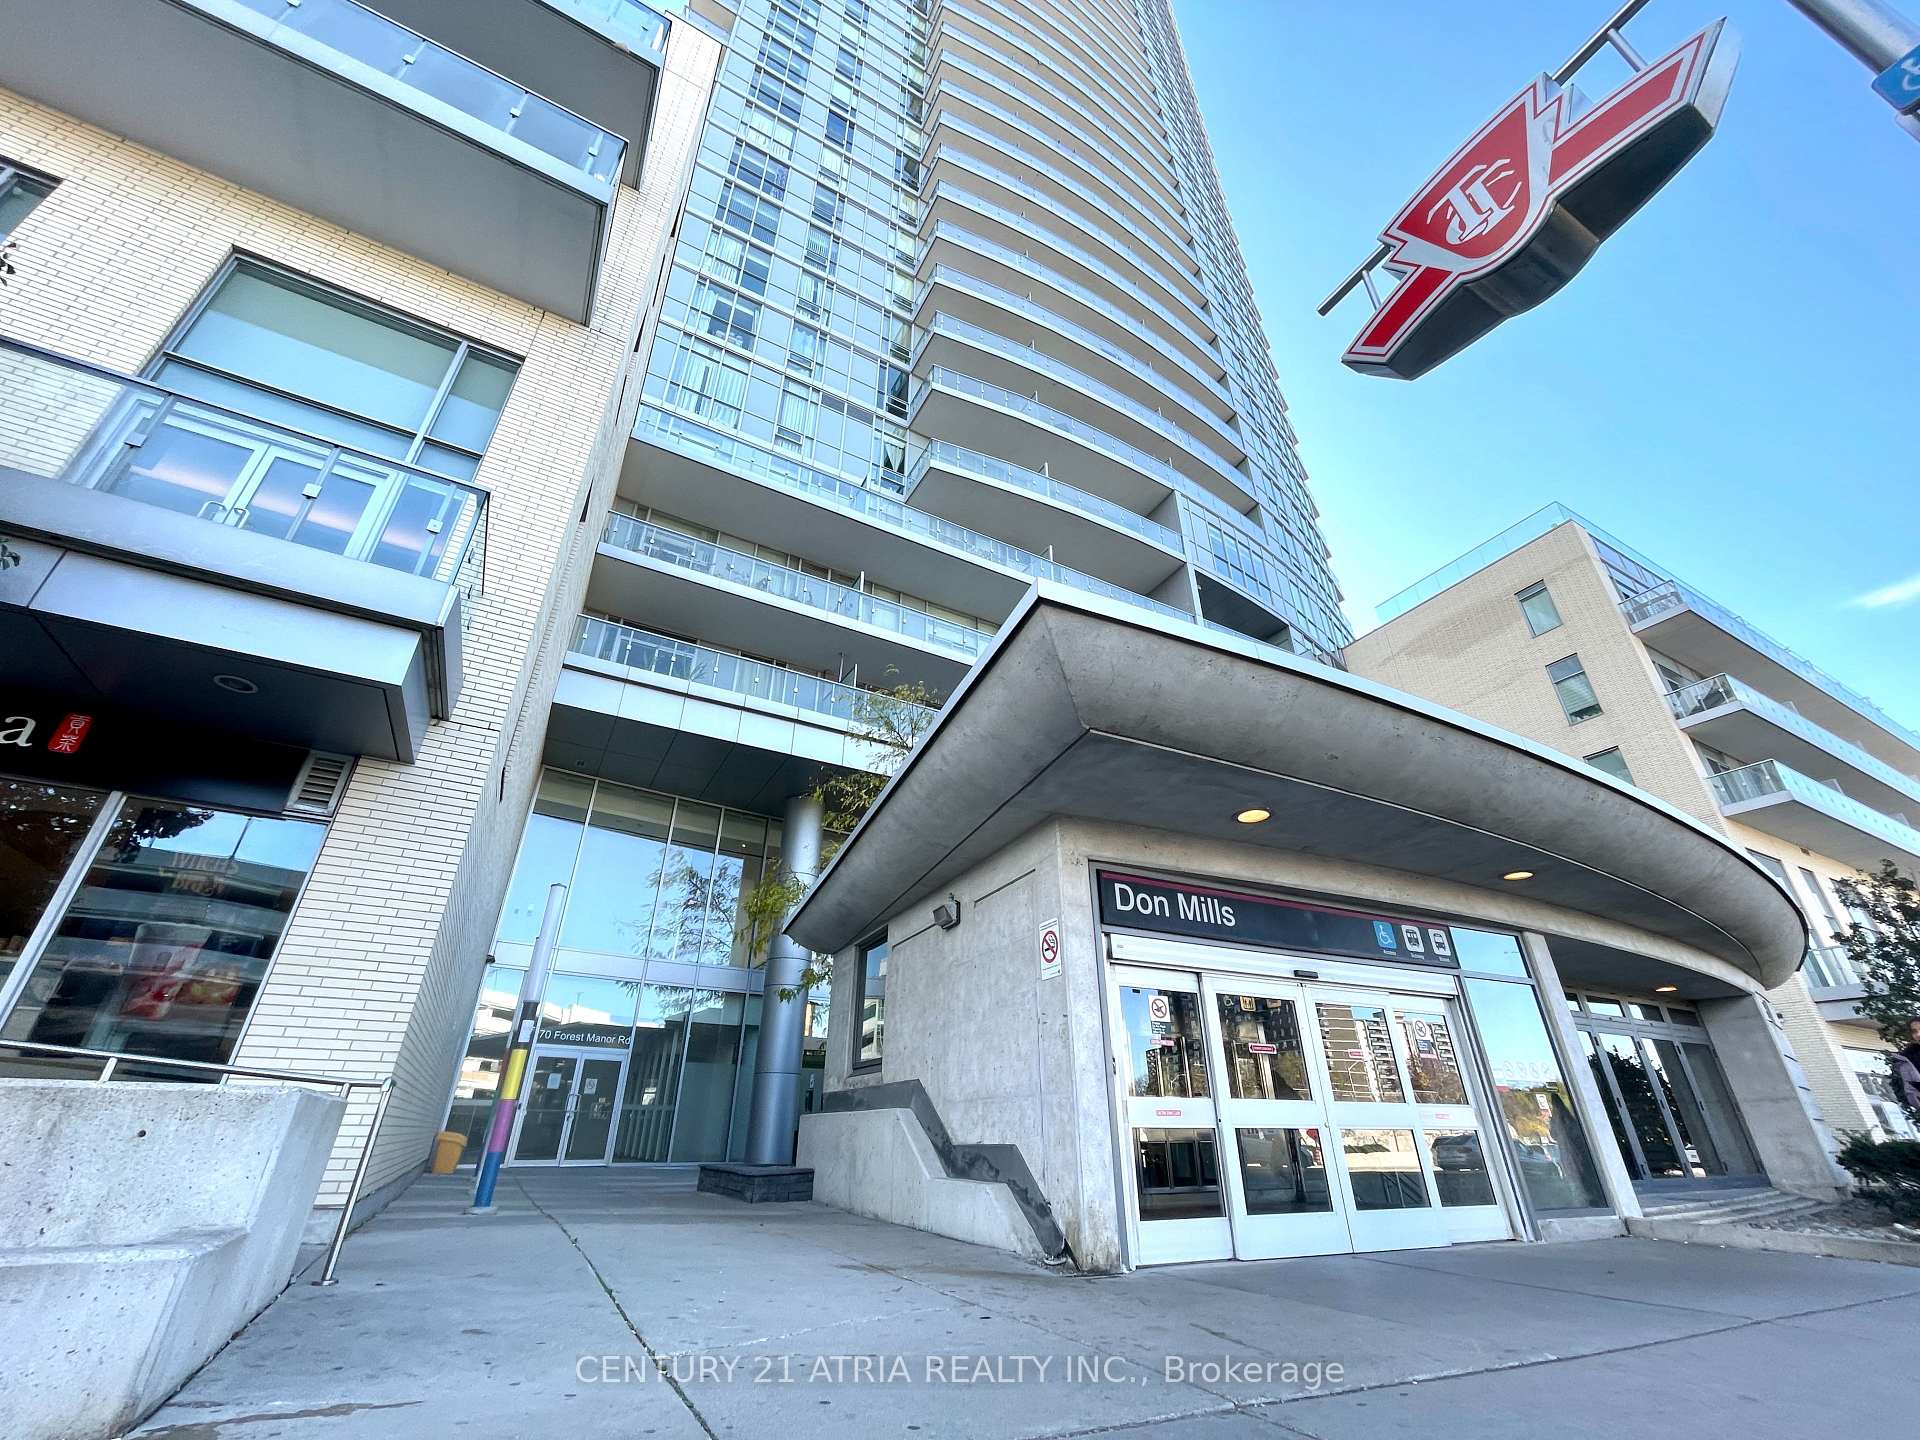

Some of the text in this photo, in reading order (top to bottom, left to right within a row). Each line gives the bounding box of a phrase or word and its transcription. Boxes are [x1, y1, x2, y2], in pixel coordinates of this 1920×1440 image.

[1114, 882, 1236, 927] Don Mills
[539, 1029, 632, 1045] 70 Forest Manor Rd
